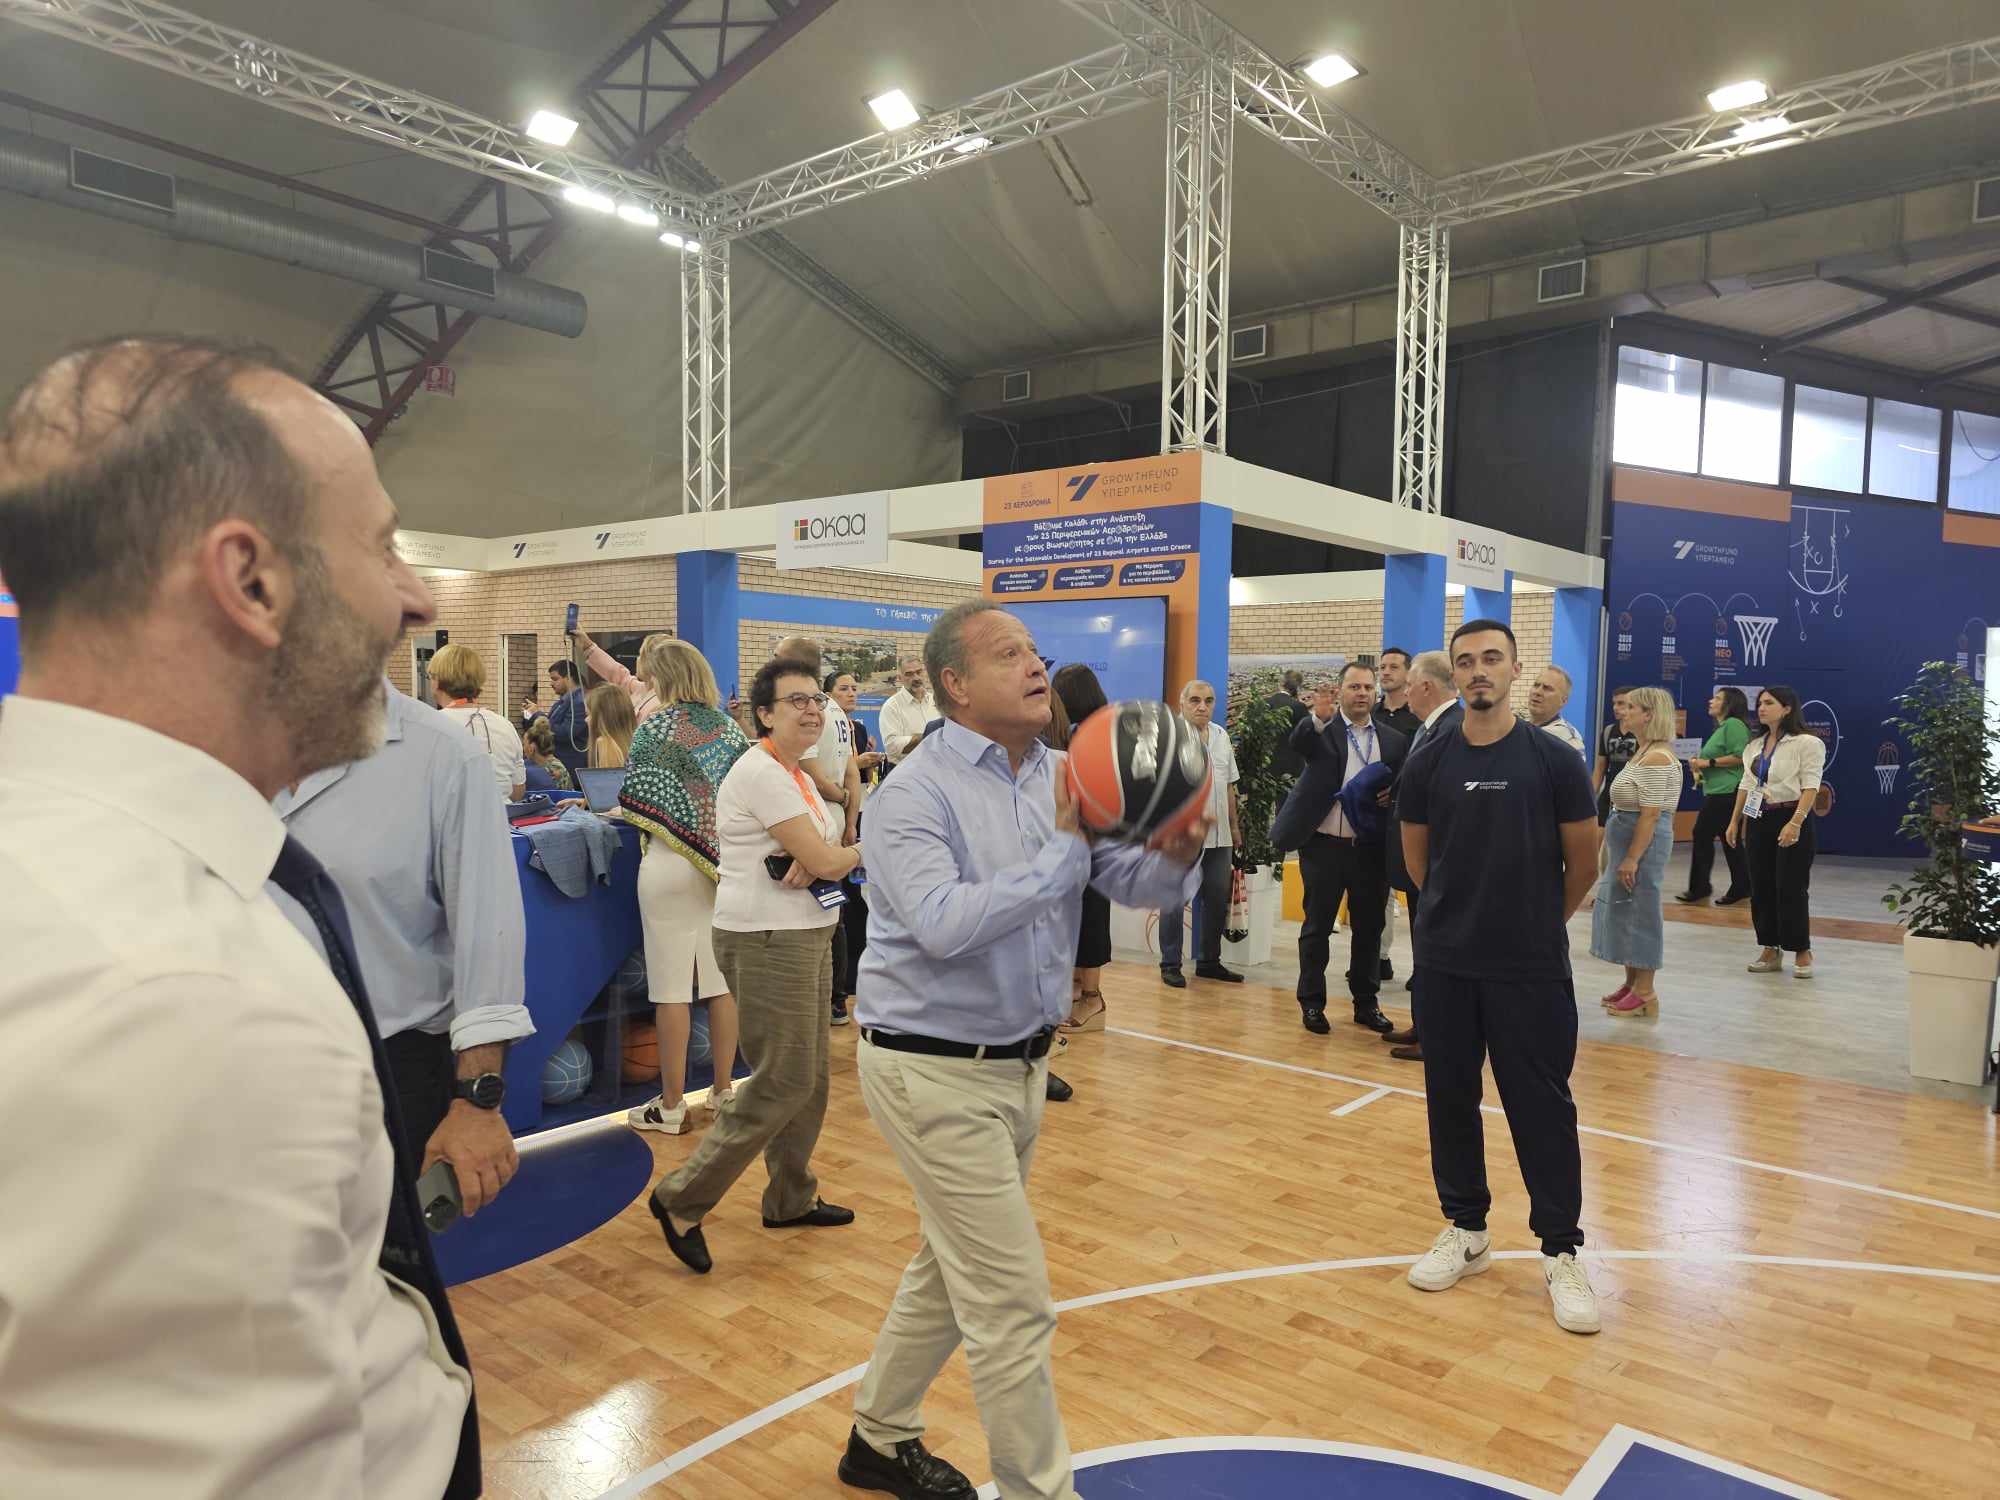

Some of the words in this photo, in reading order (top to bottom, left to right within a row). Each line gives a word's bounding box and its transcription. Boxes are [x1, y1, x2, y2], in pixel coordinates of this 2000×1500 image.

[1102, 467, 1179, 486] GROWTHFUND
[1102, 481, 1172, 498] ΥΠΕΡΤΑΜΕΙΟ
[1110, 512, 1146, 523] Ανάπτυξη
[1140, 531, 1168, 541] Ελλάδα
[835, 719, 848, 743] 16
